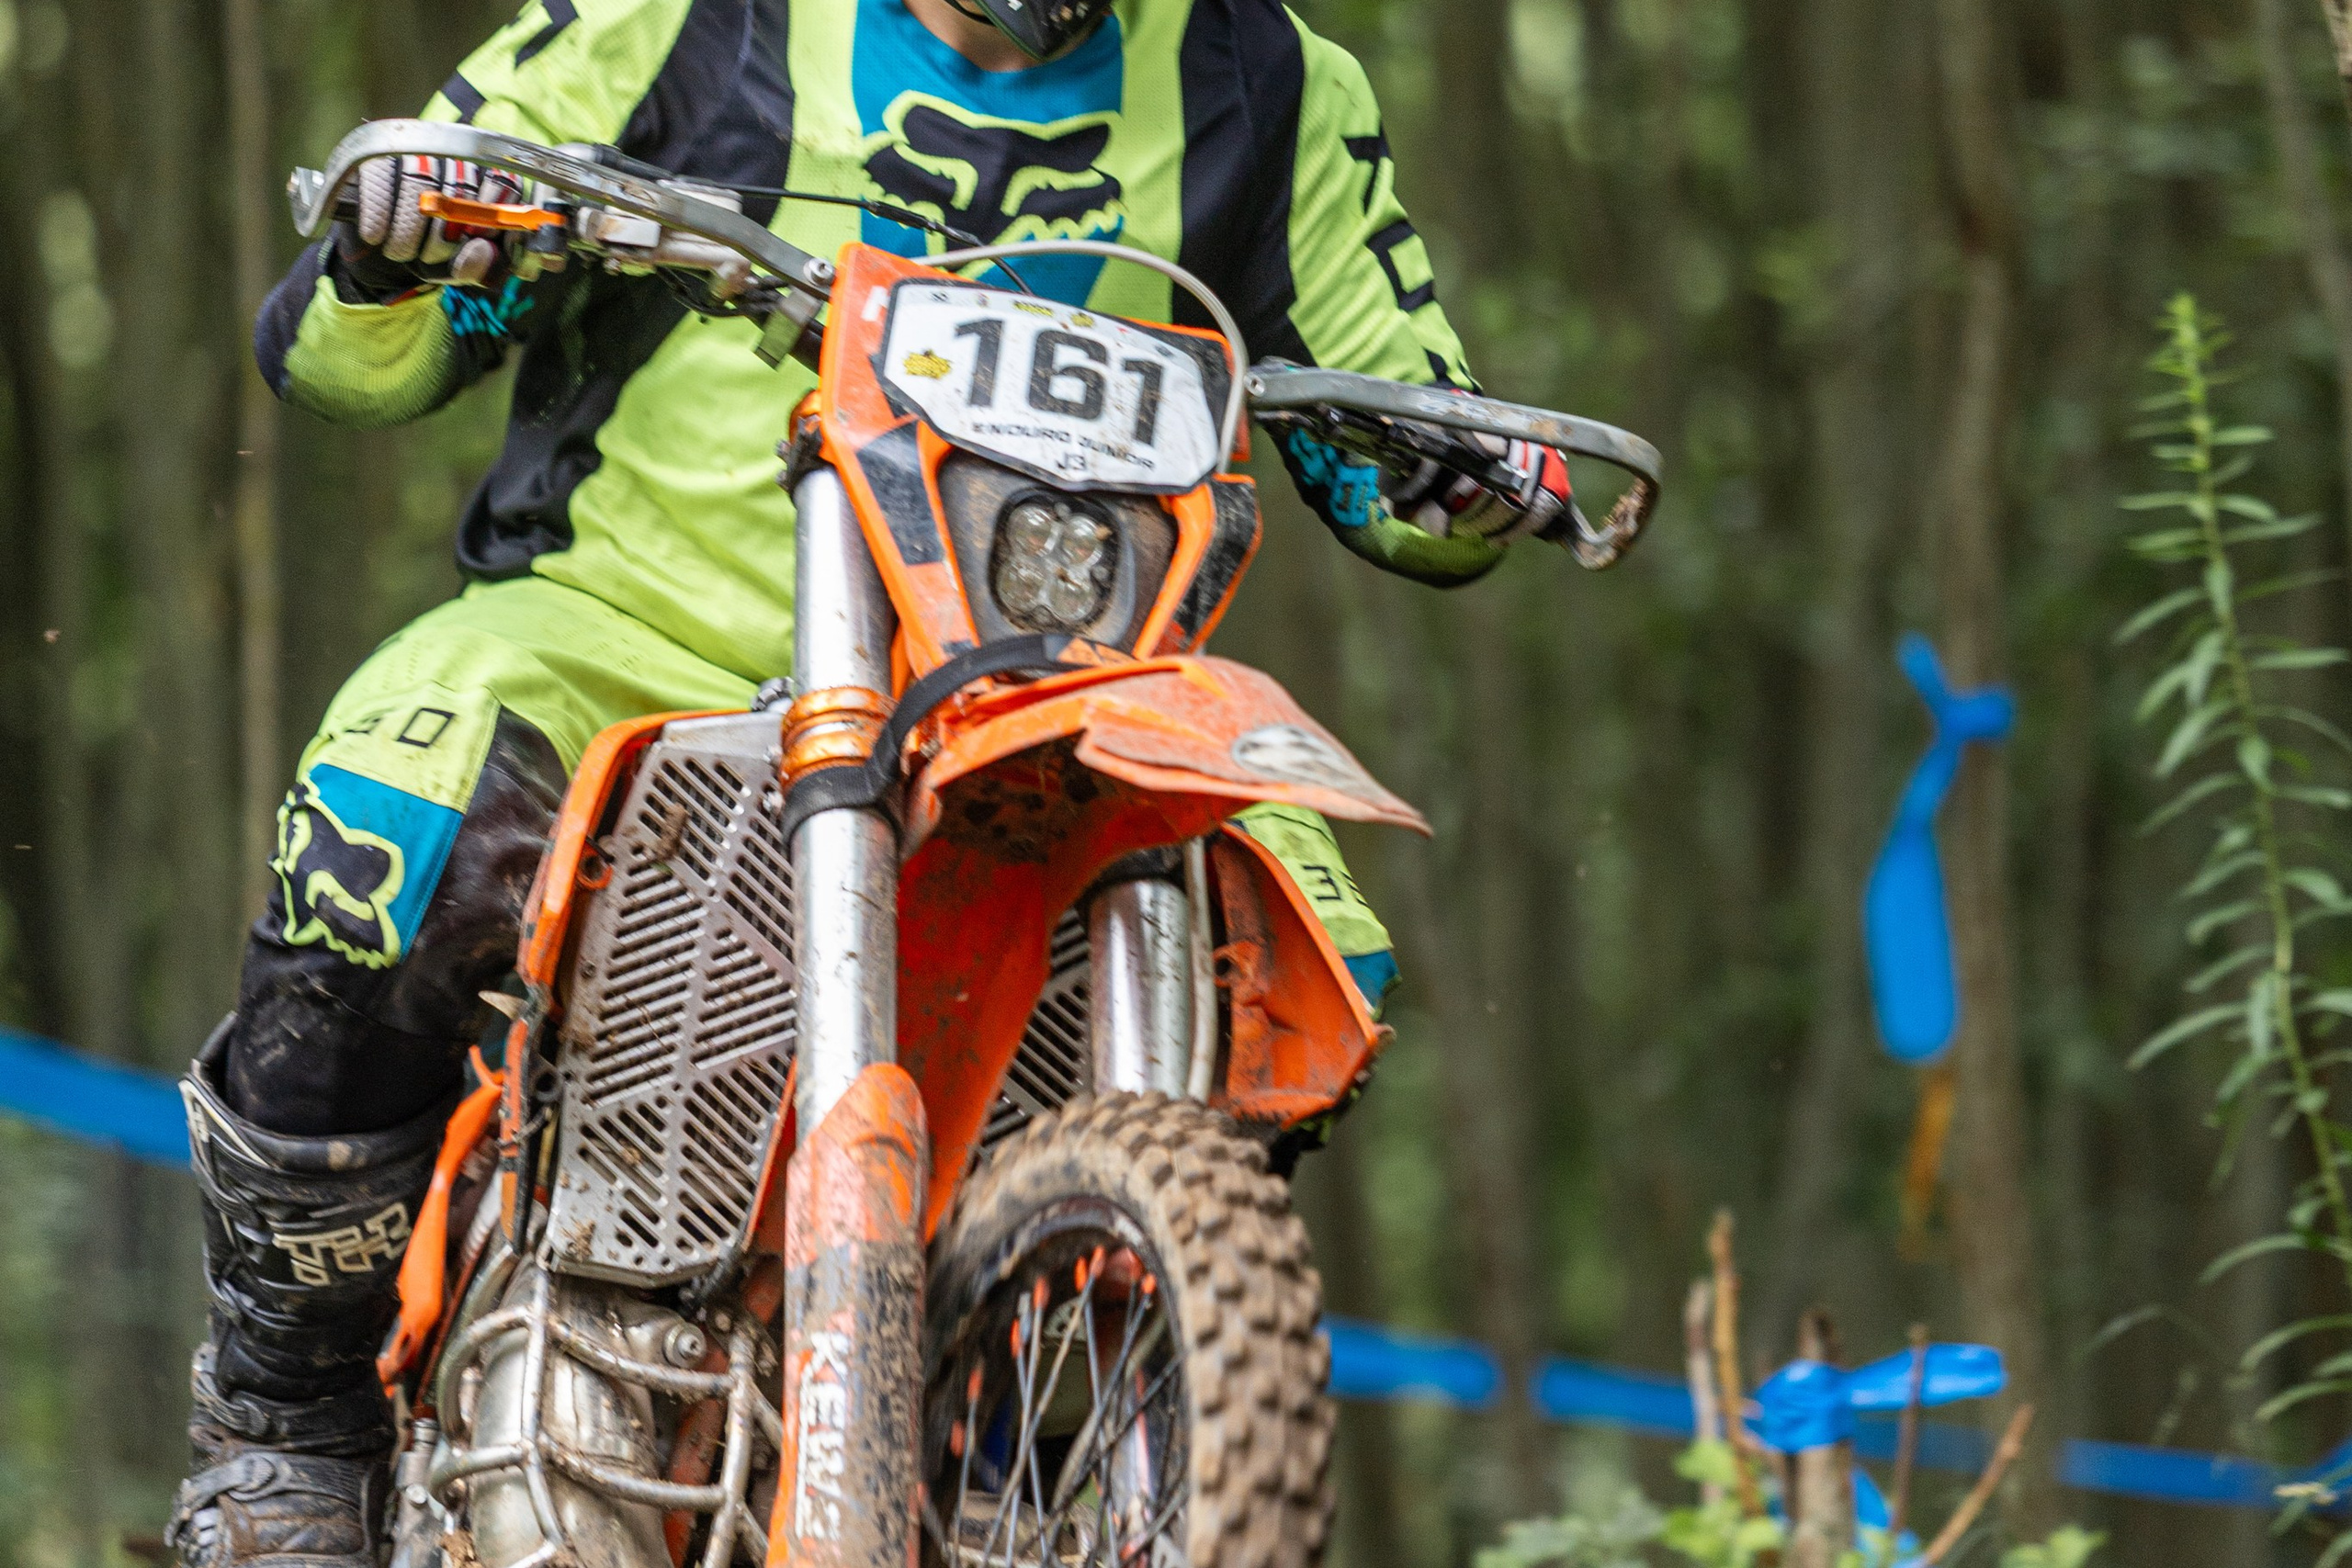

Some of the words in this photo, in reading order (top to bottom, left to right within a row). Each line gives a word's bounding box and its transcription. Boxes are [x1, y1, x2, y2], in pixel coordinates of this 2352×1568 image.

[955, 317, 1166, 448] 161
[972, 422, 1071, 444] ENDURO
[1056, 452, 1087, 471] J3
